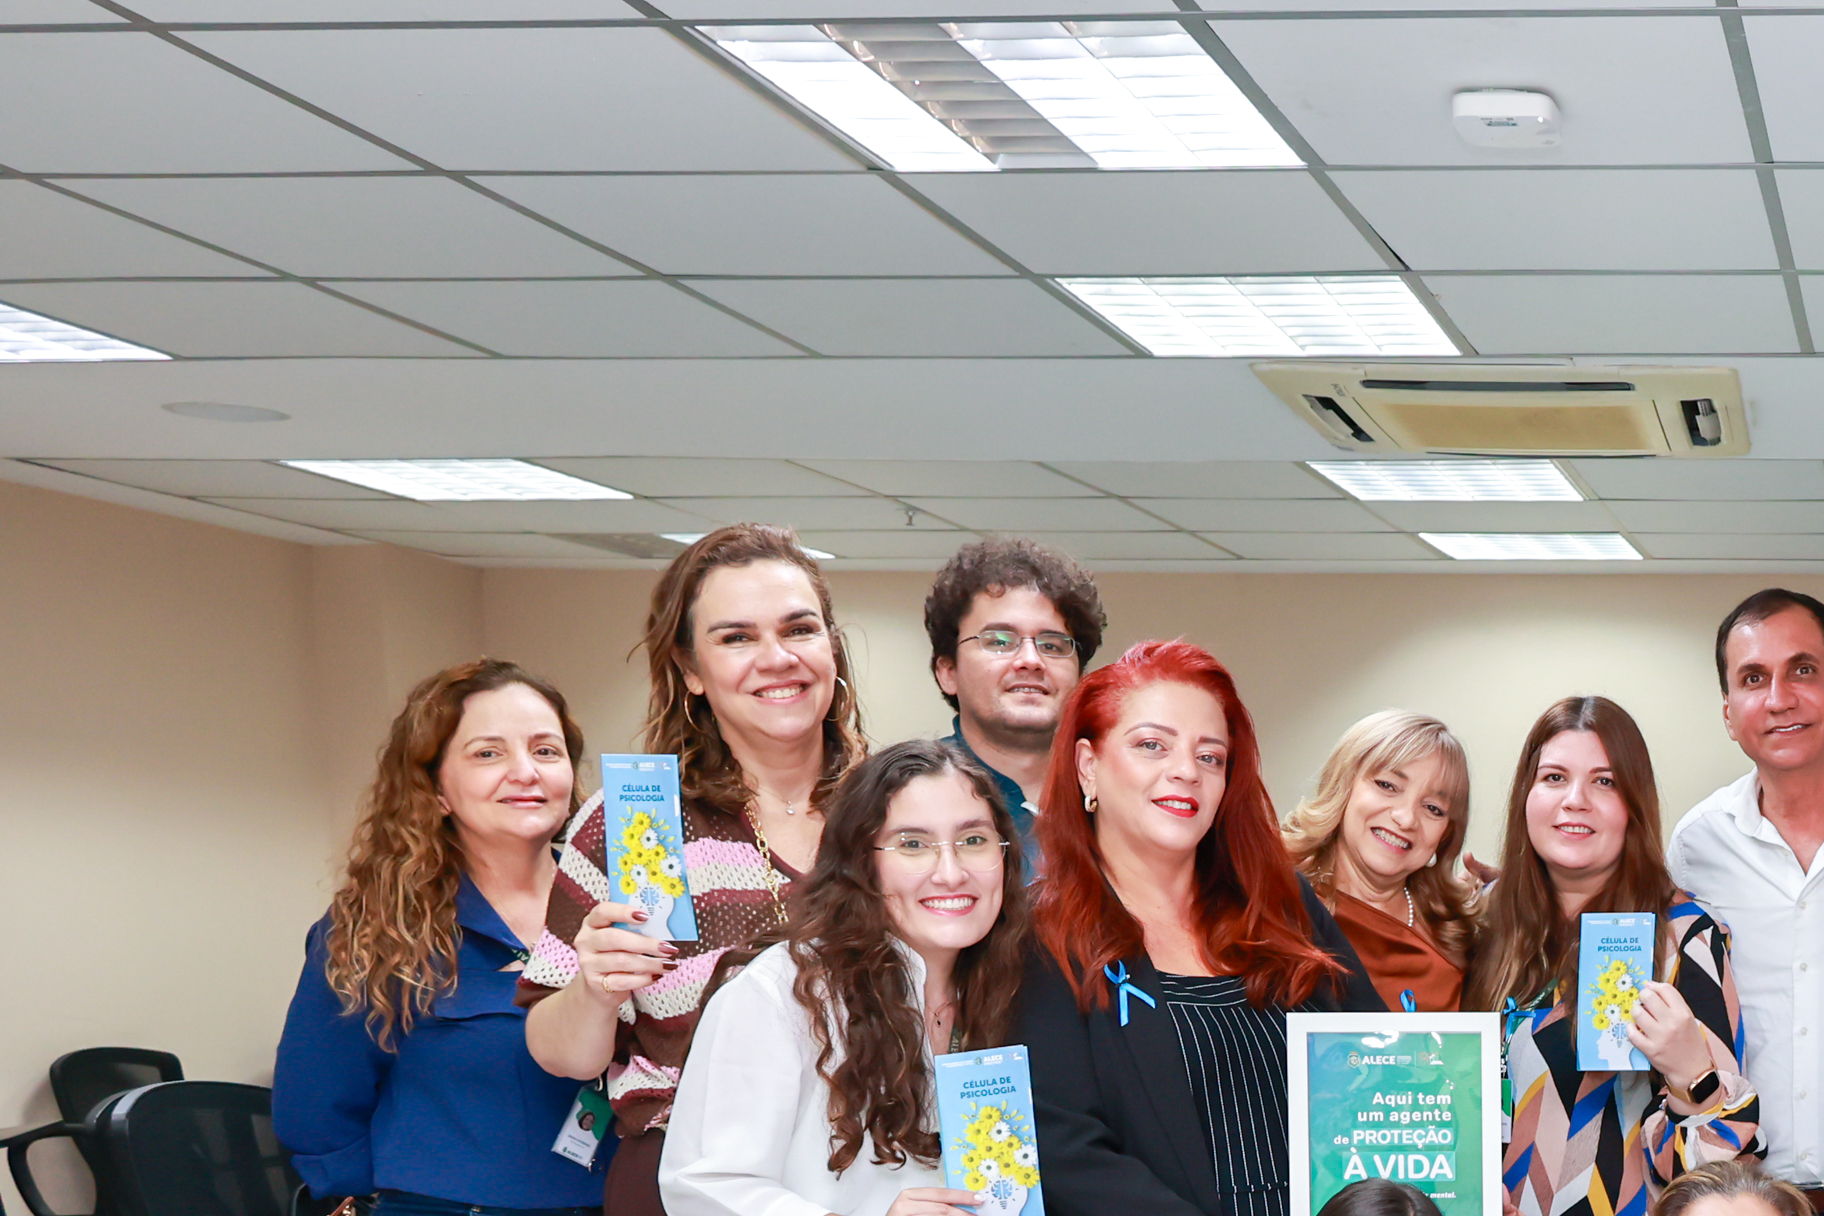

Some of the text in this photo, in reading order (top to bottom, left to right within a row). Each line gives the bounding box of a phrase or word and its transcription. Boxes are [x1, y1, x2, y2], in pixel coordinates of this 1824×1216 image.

[622, 784, 650, 792] CÉLULA
[620, 794, 665, 802] PSICOLOGIA
[1601, 936, 1628, 944] CÉLULA
[1362, 1055, 1396, 1065] ALECE
[963, 1076, 1011, 1089] CÉLULA DE
[960, 1085, 1016, 1099] PSICOLOGIA
[1372, 1091, 1451, 1107] Aqui tem
[1358, 1109, 1451, 1124] um agente
[1334, 1126, 1452, 1148] de PROTEÇÃO
[1344, 1147, 1453, 1180] À VIDA
